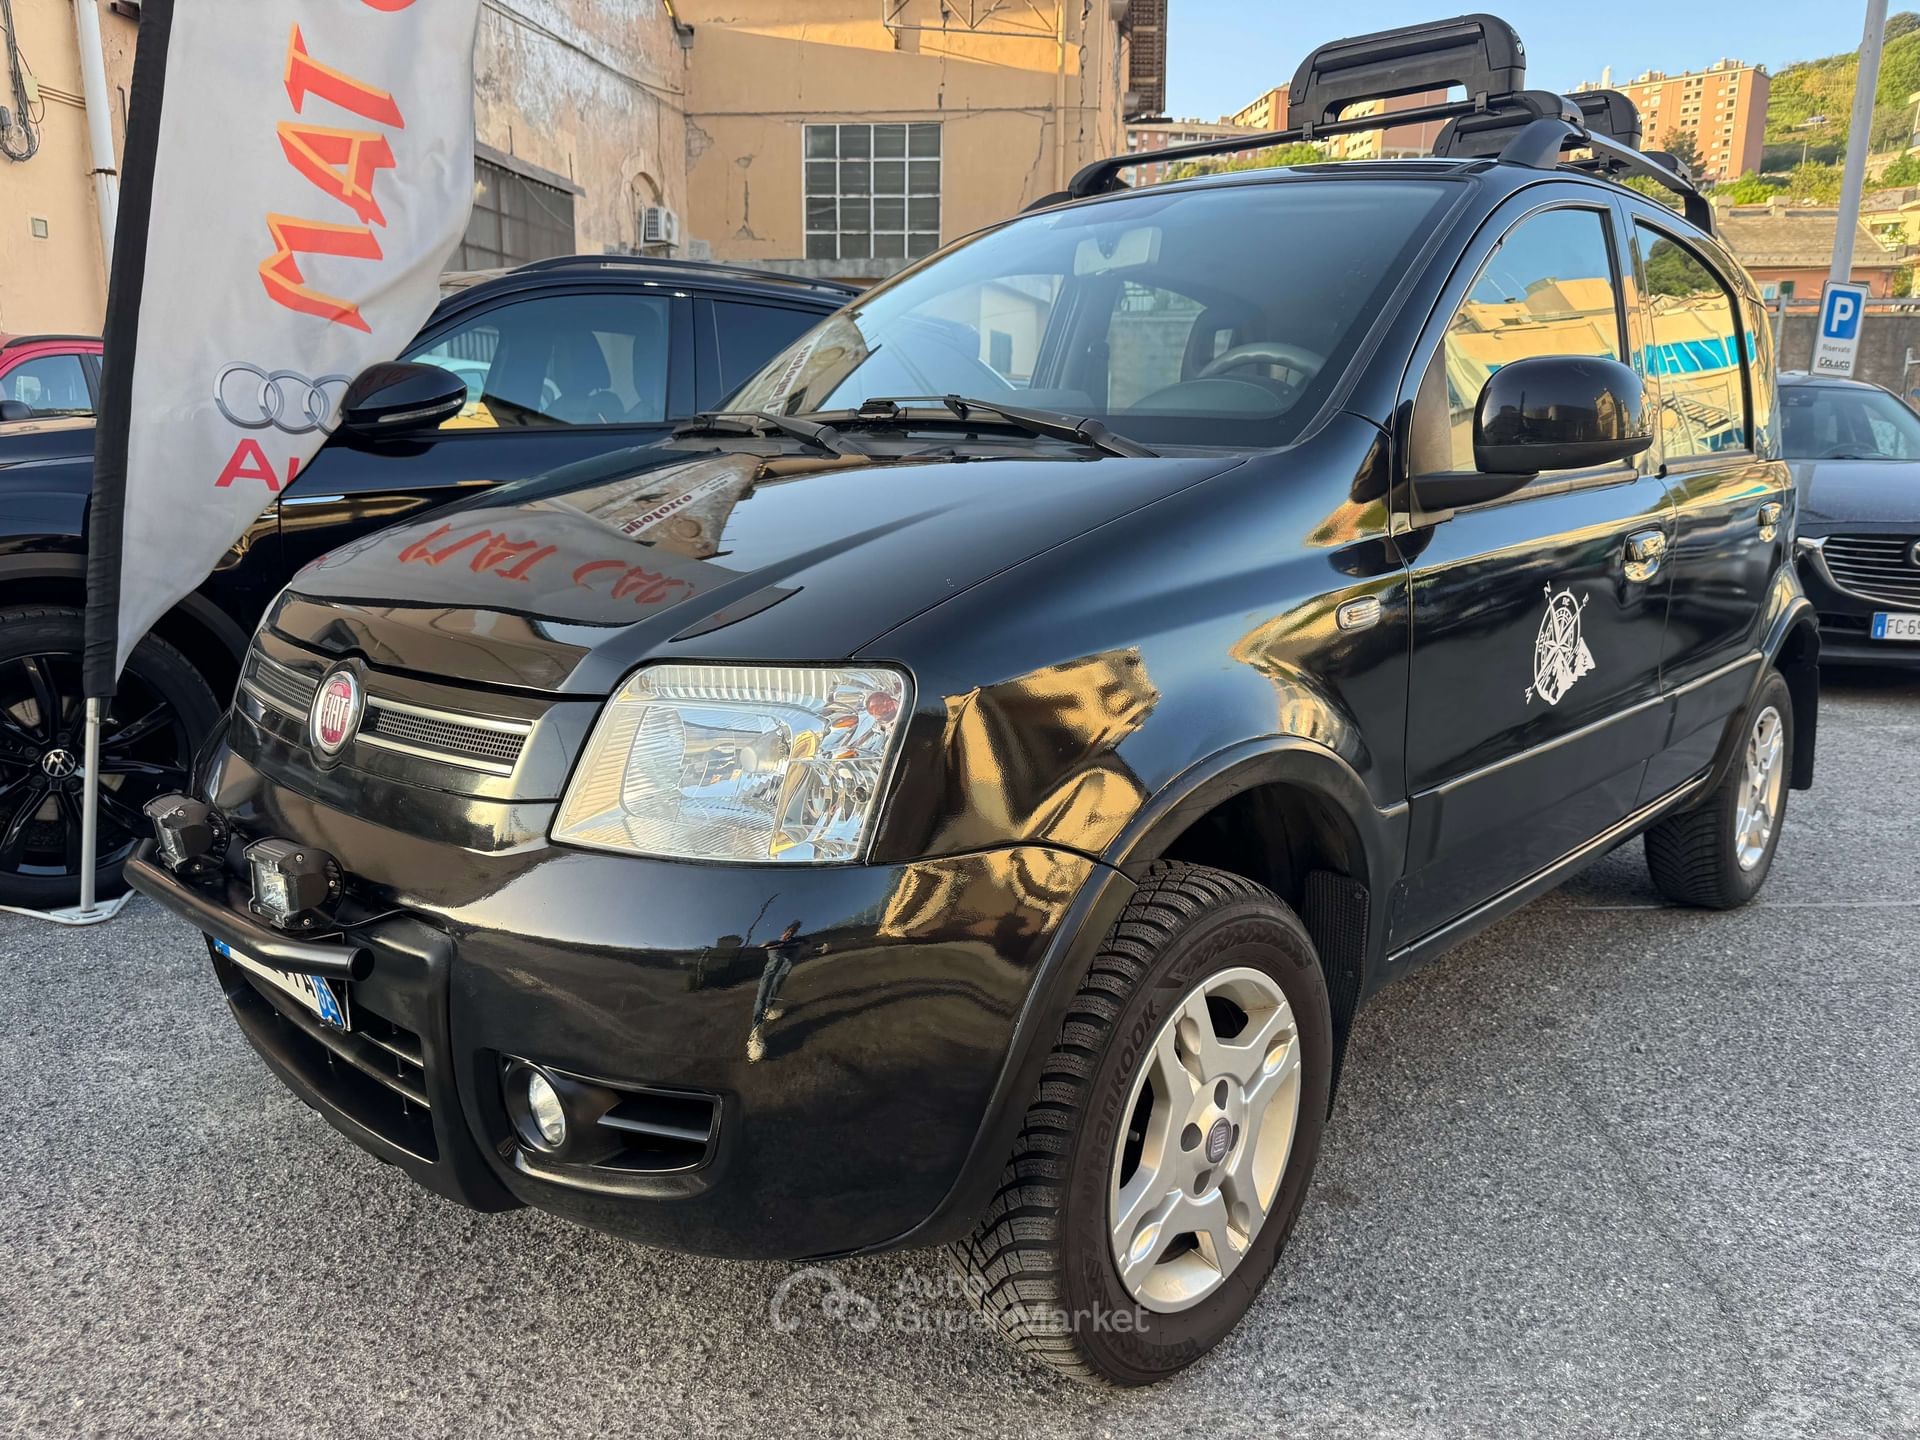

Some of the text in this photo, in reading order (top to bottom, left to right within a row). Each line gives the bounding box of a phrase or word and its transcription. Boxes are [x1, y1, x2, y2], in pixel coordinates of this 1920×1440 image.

[259, 23, 405, 334] MAT
[1830, 296, 1854, 332] P
[321, 693, 350, 733] FIAT
